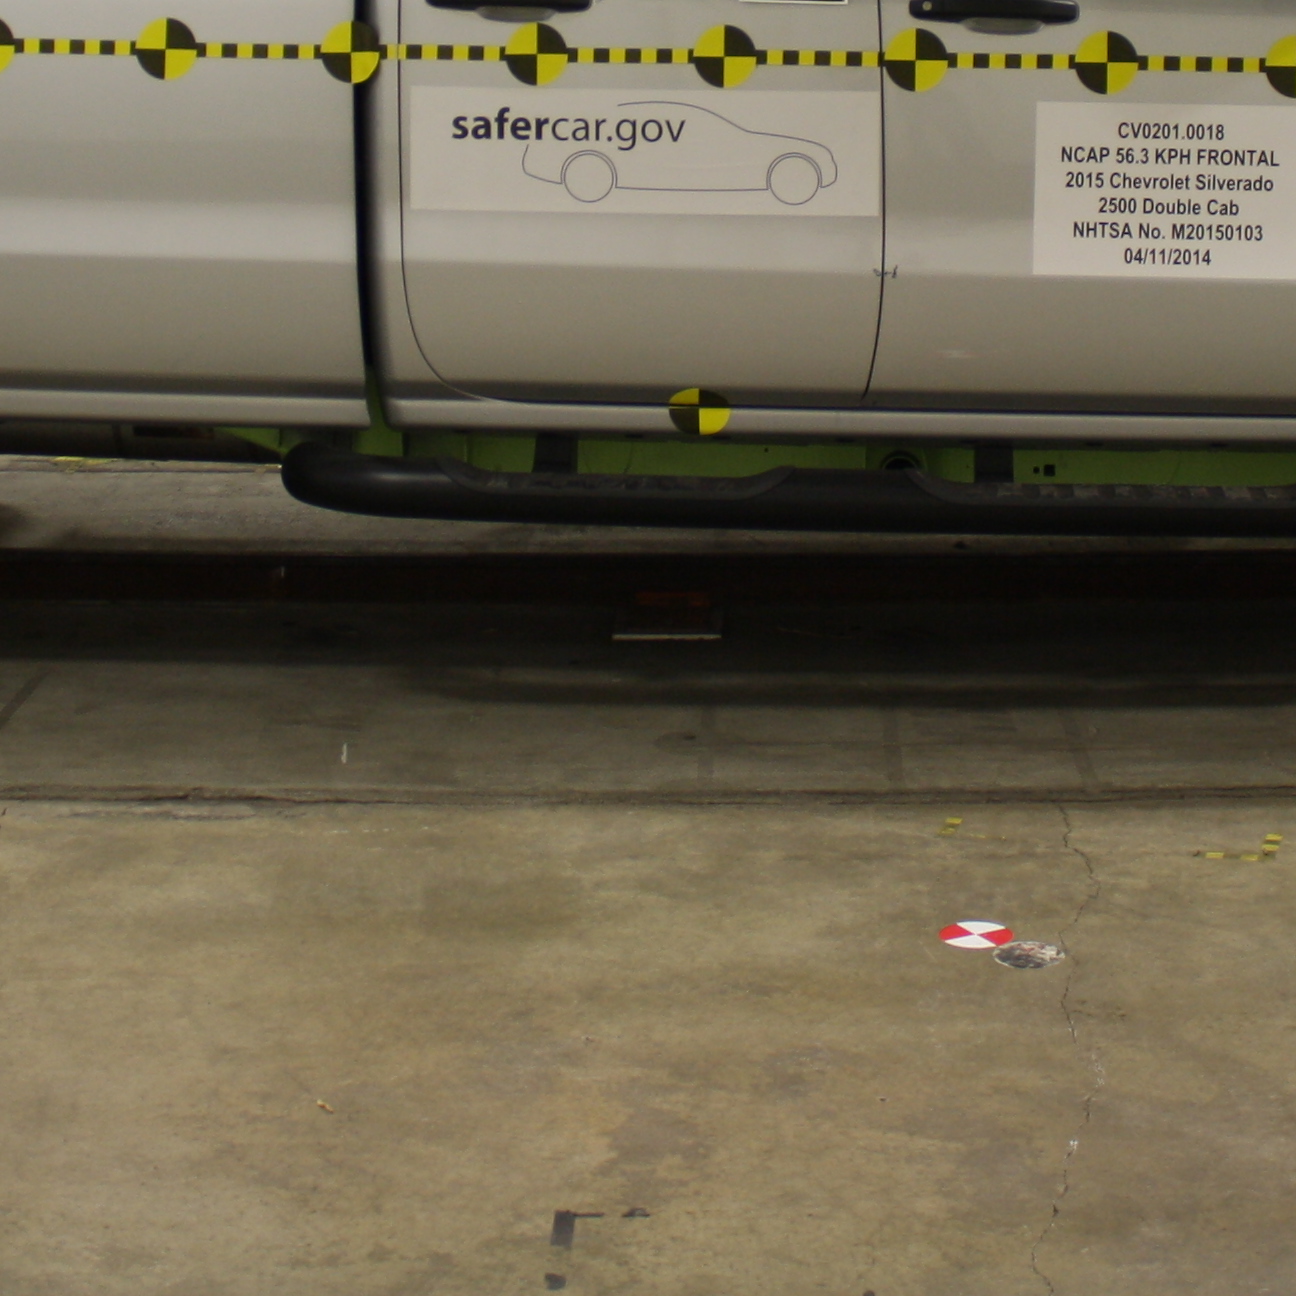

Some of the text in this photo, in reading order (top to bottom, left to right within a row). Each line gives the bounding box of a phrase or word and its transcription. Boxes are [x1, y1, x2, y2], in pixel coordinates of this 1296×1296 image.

[452, 107, 686, 151] safercar.gov
[1118, 122, 1225, 140] CV0201.0018
[1061, 146, 1280, 167] NCAP 56.3 KPH FRONTAL
[1065, 171, 1274, 192] 2015 Chevrolet Silverado
[1098, 197, 1240, 216] 2500 Double Cab
[1073, 221, 1264, 241] NHTSA No. M20150103
[1124, 247, 1212, 265] 04/11/2014
